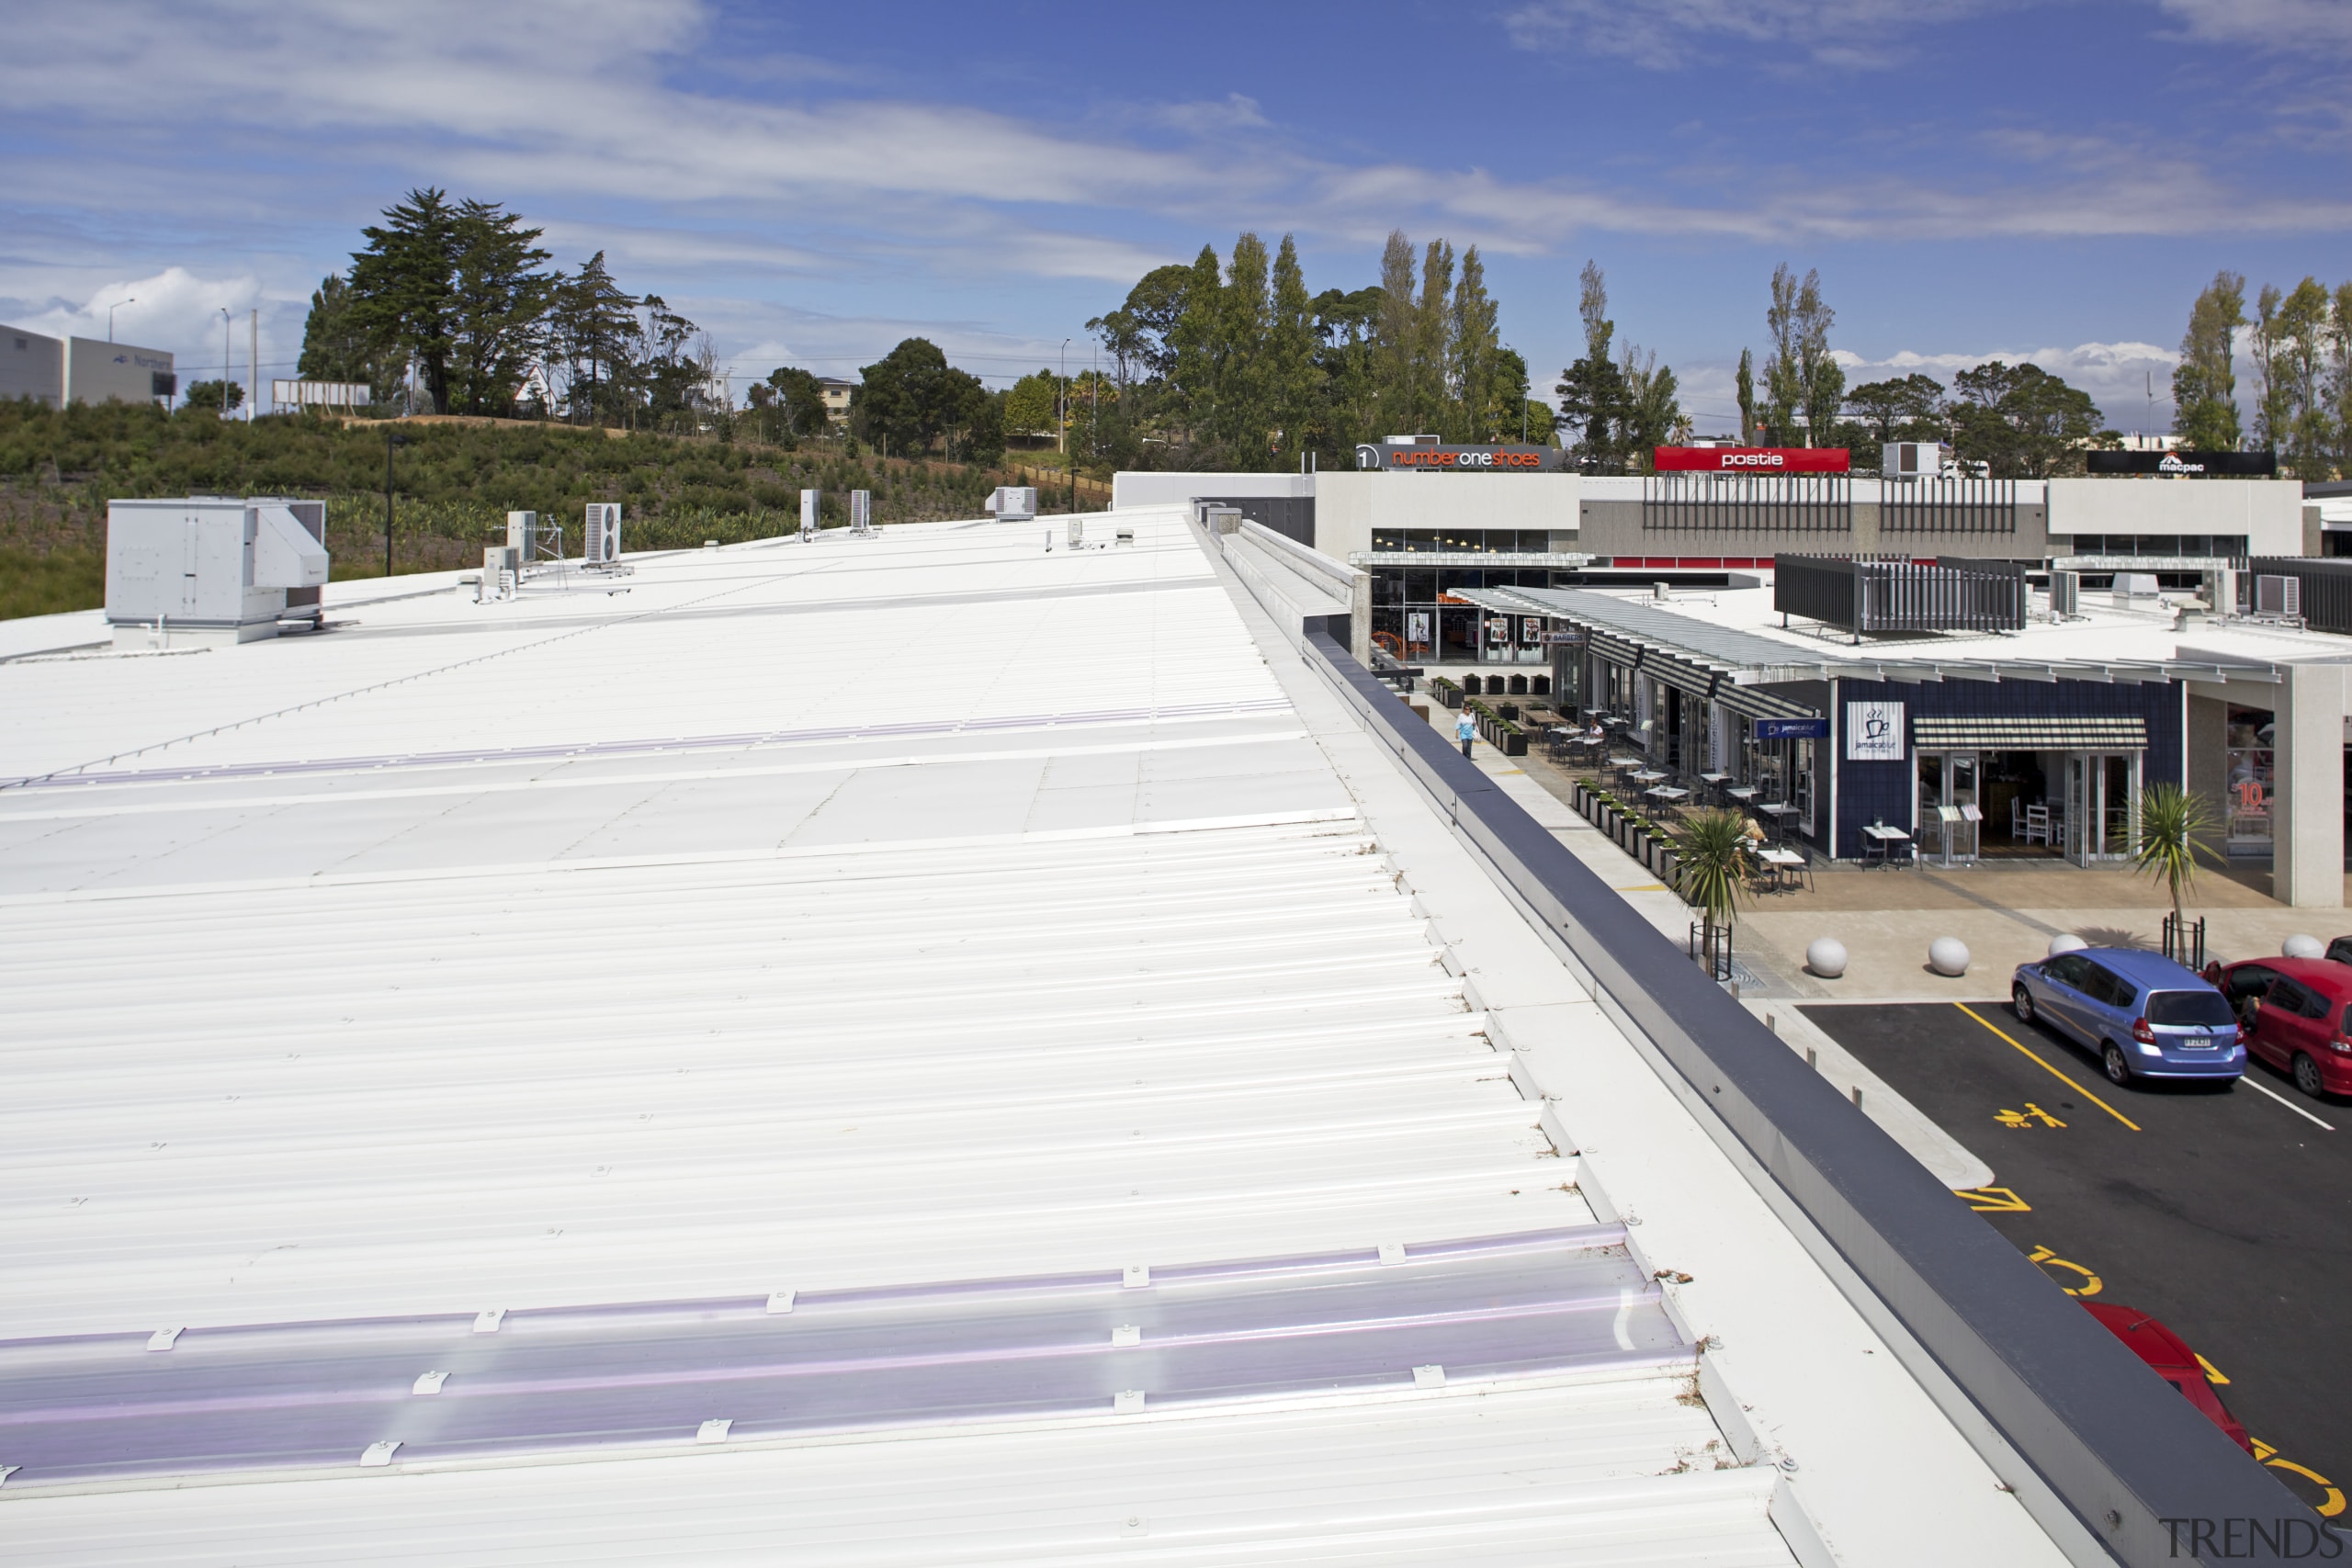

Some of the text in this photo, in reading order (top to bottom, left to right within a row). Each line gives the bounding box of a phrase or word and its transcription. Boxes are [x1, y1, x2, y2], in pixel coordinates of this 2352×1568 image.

[1393, 447, 1540, 467] numberoneshoes
[1722, 451, 1783, 468] postie
[2159, 464, 2204, 473] macpac
[1855, 739, 1896, 750] jamaicablue
